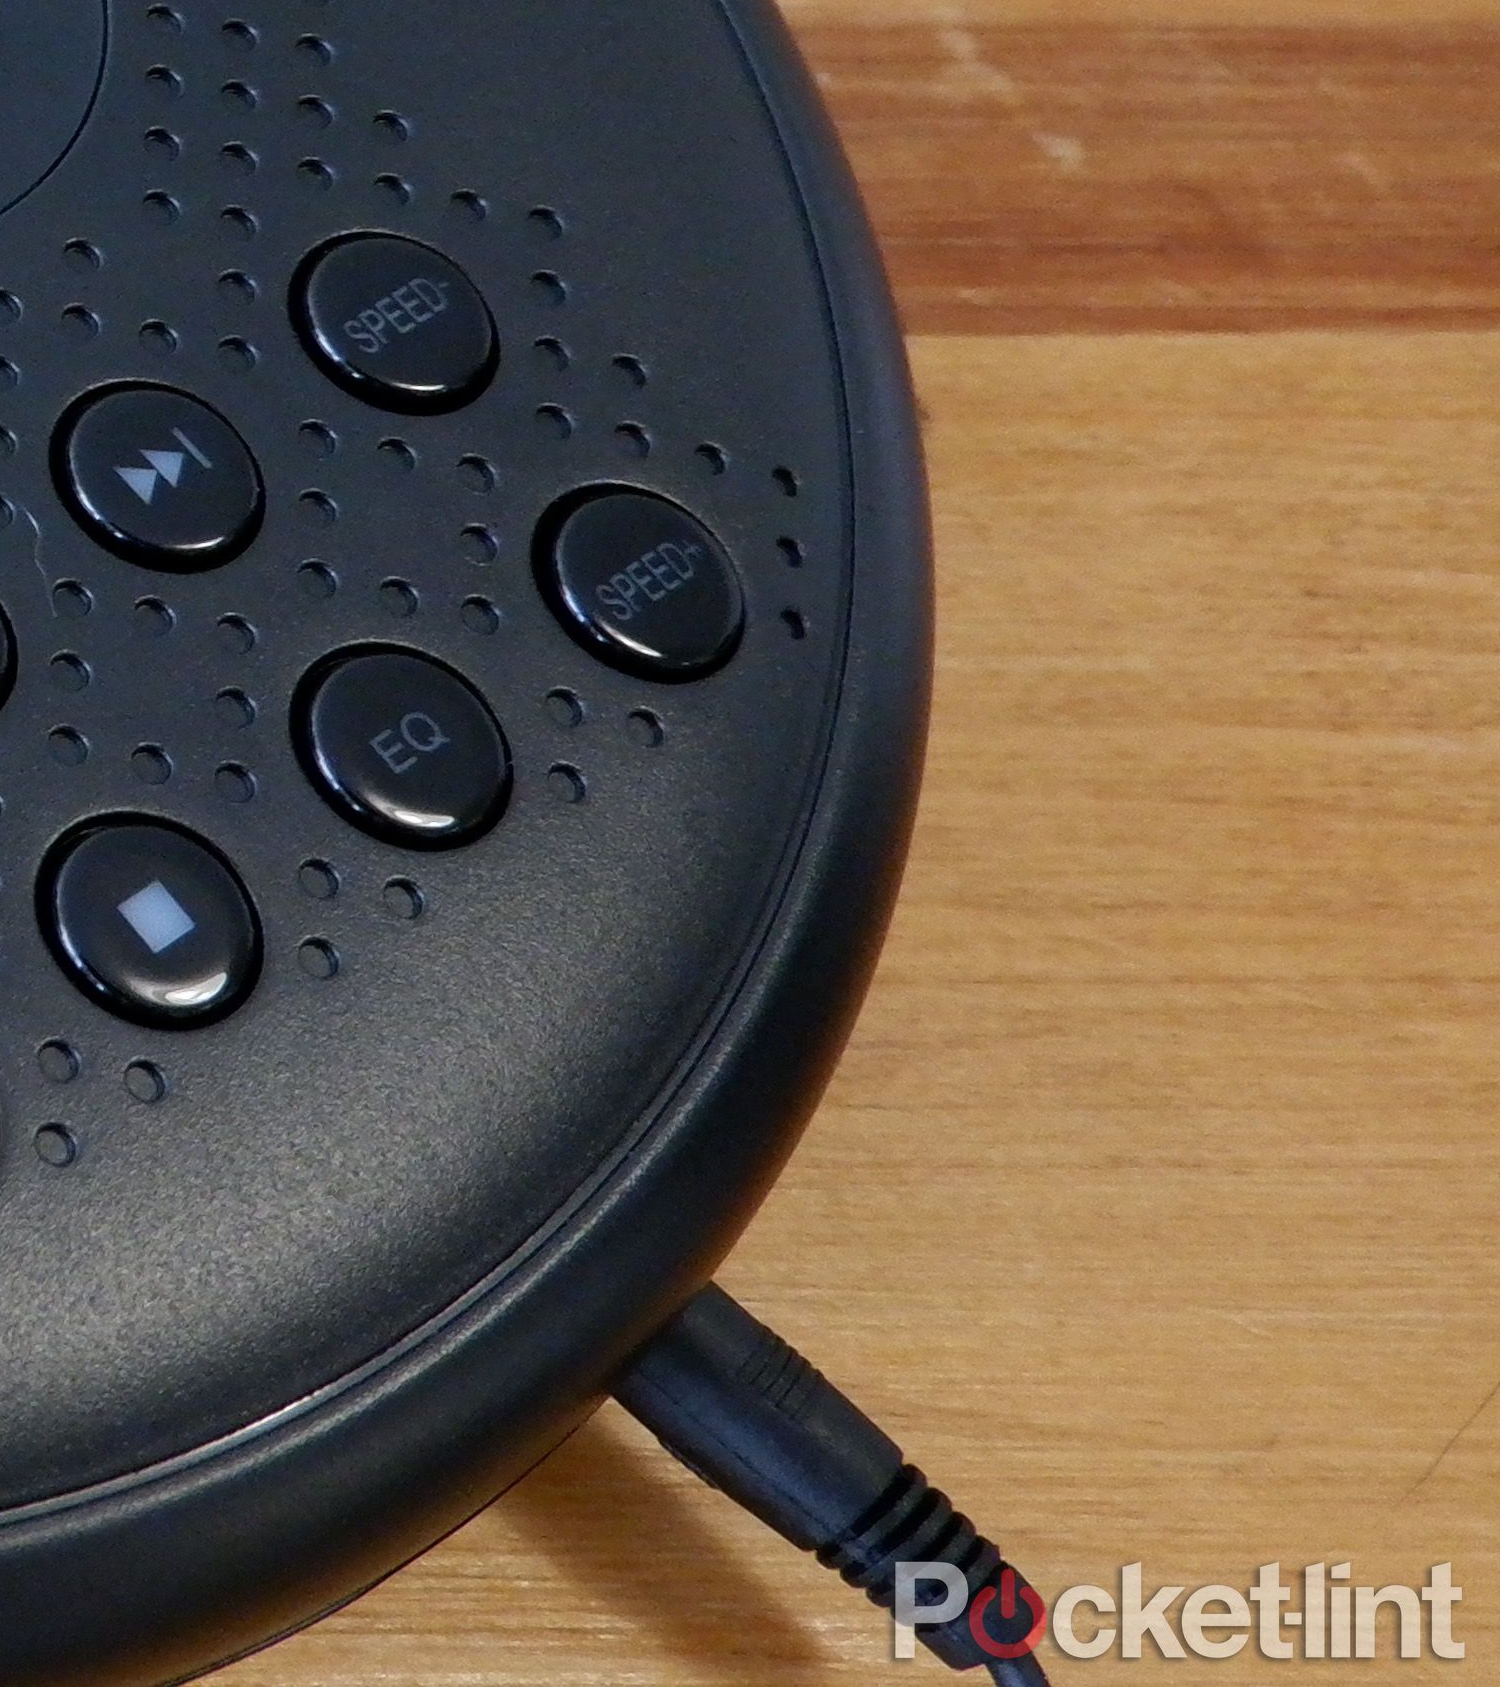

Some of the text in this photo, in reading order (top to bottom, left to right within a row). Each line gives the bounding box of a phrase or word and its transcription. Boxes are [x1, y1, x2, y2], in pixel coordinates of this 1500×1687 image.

[342, 277, 450, 353] SPEED-
[595, 539, 701, 621] SPEED+
[368, 712, 450, 774] EQ
